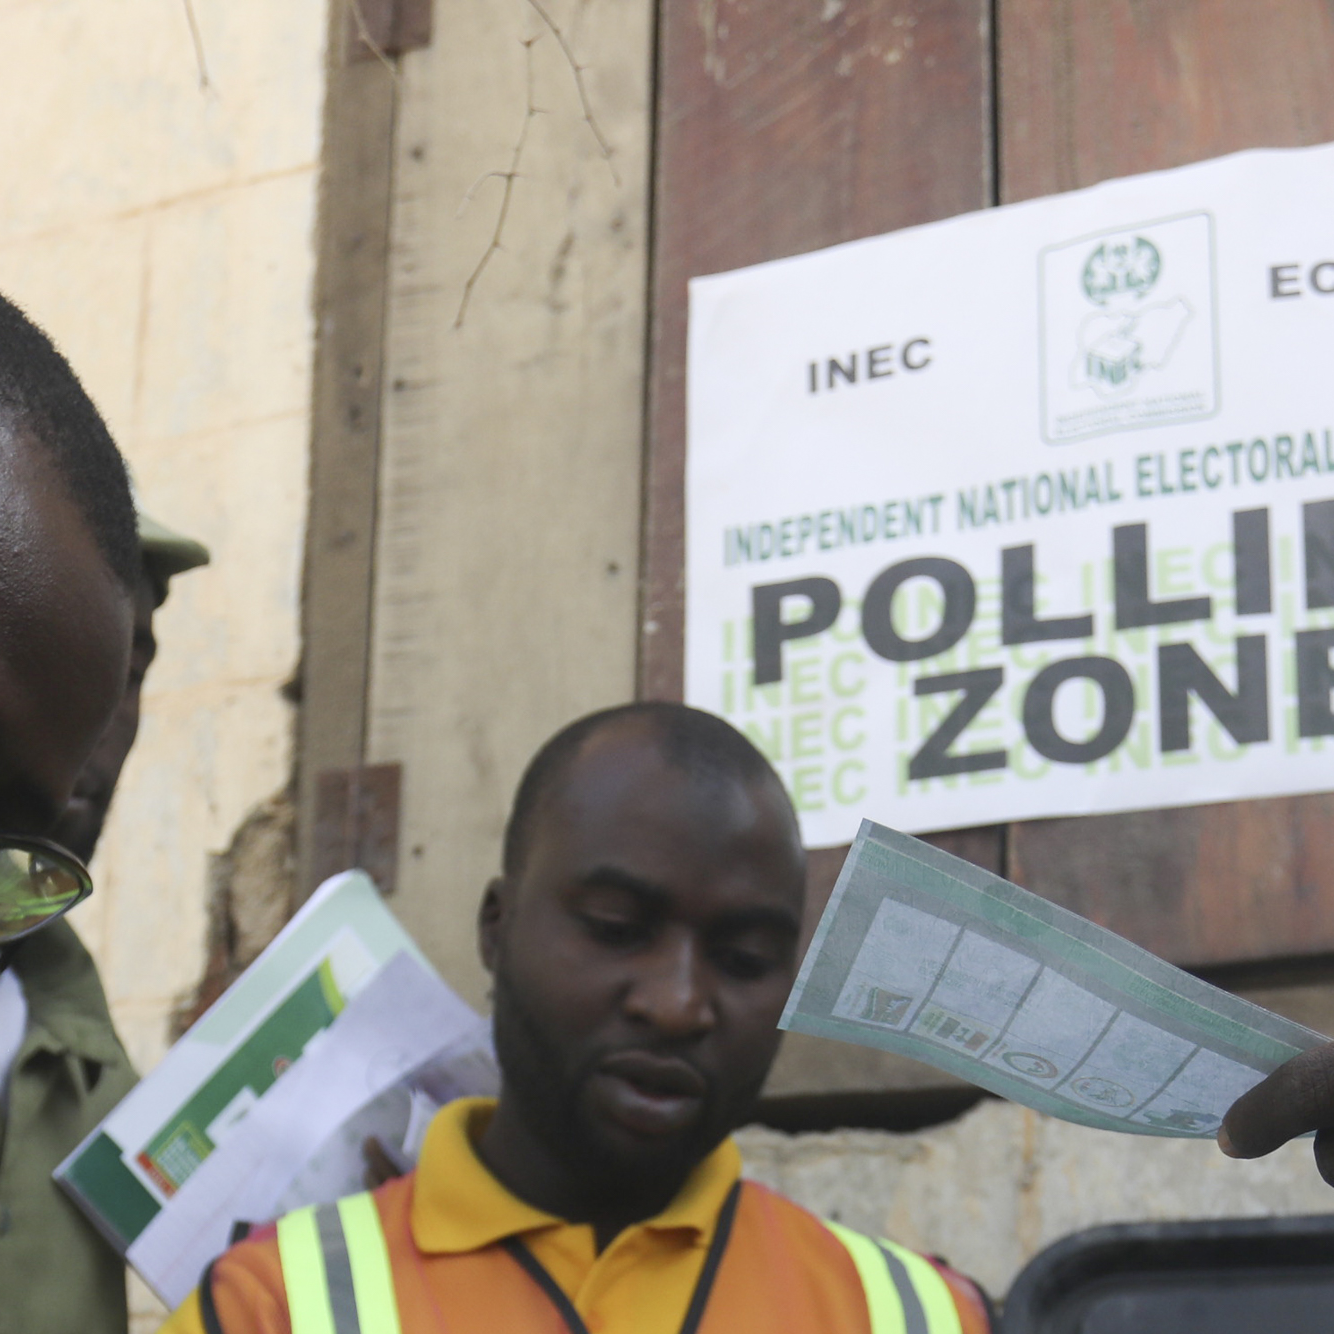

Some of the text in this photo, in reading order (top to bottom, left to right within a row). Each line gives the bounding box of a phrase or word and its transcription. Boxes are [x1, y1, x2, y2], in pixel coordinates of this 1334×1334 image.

[808, 336, 933, 394] INEC
[723, 495, 945, 567] INDEPENDENT
[956, 467, 1124, 530] NATIONAL
[745, 705, 867, 762] NEC
